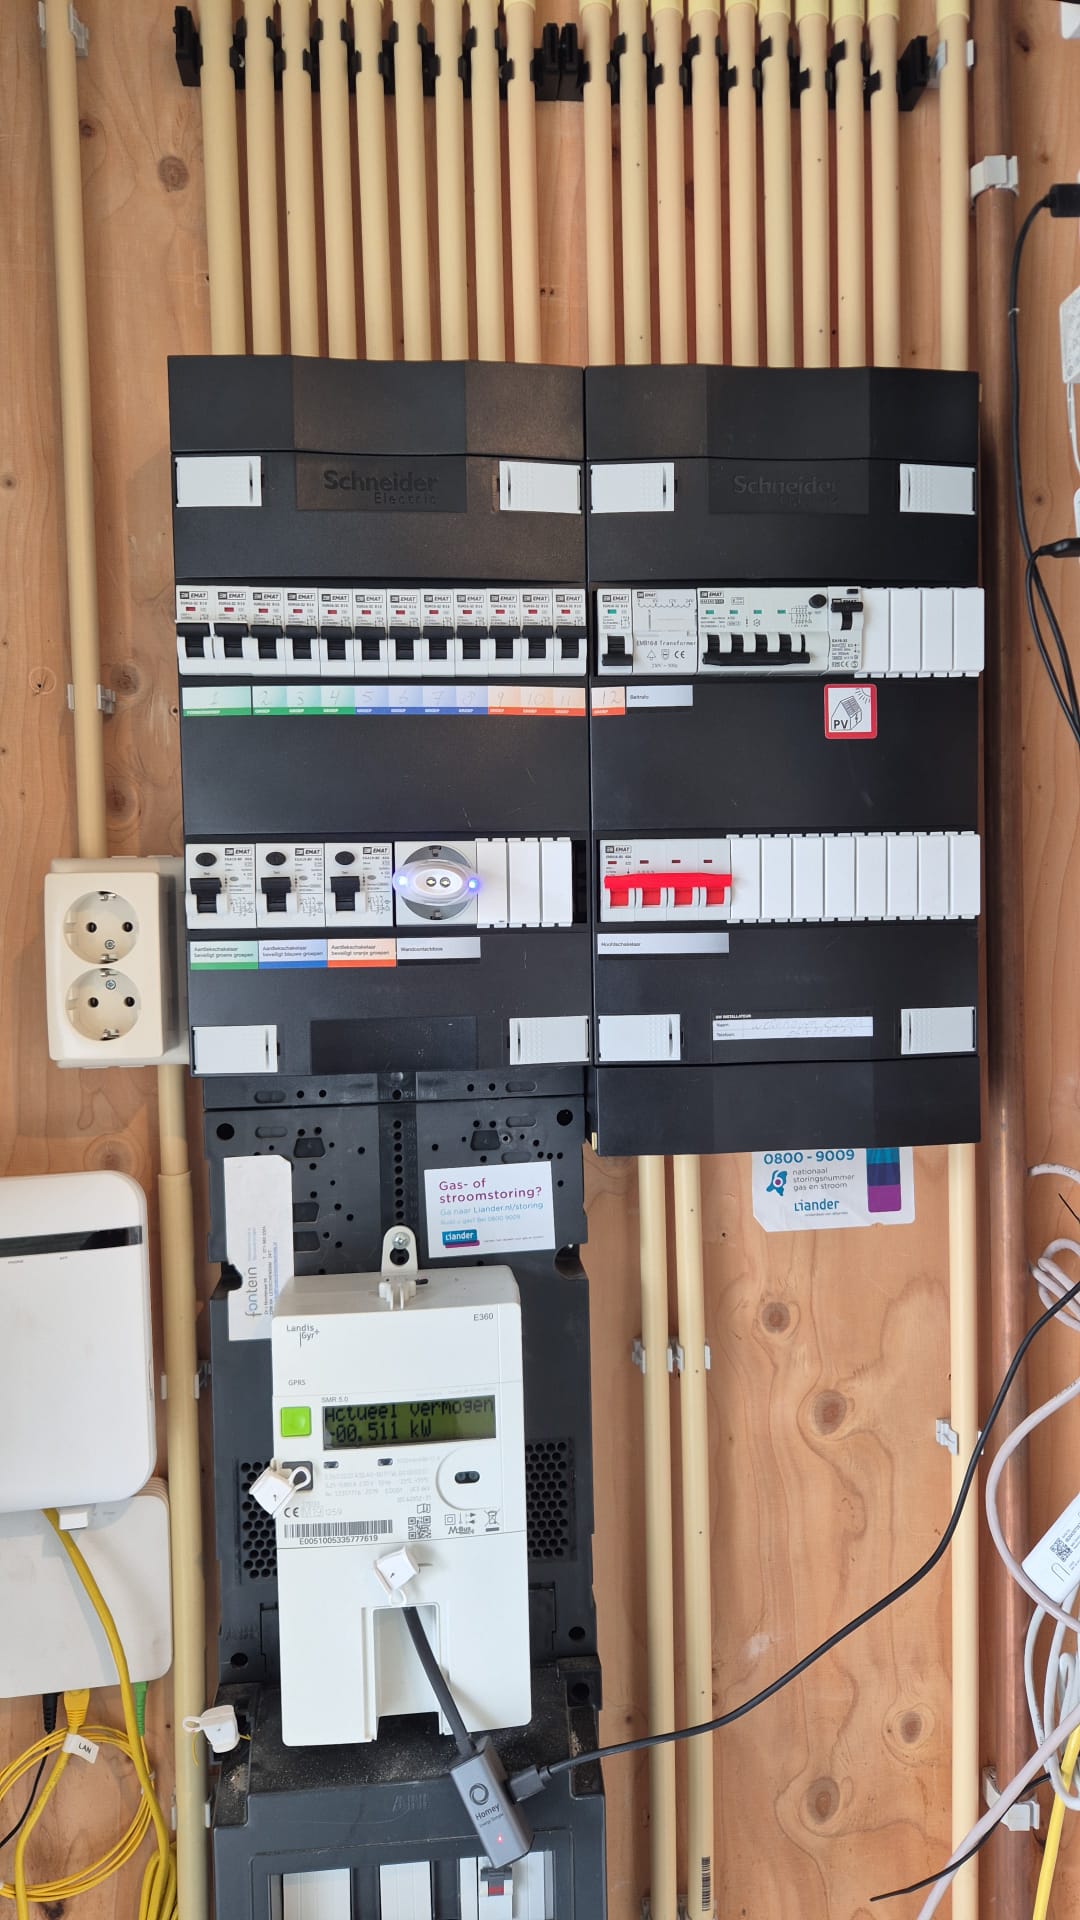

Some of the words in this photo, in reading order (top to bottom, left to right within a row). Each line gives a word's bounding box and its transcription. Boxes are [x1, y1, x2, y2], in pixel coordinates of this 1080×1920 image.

[323, 470, 438, 491] Schneider
[374, 492, 437, 504] Electric
[602, 690, 621, 705] 12
[833, 719, 849, 729] PV
[764, 1152, 804, 1165] 0800
[816, 1149, 855, 1162] 9009
[792, 1167, 828, 1176] nationaal
[439, 1180, 468, 1191] Gas-
[472, 1178, 486, 1188] of
[793, 1174, 855, 1184] storingsnummer
[794, 1184, 807, 1192] gas
[820, 1182, 848, 1190] stroom
[440, 1186, 542, 1204] stroomstoring?
[473, 1202, 544, 1214] Liander.nl/storing
[794, 1198, 840, 1212] Liander
[445, 1232, 474, 1241] Liander
[245, 1266, 262, 1317] fontein
[473, 1312, 494, 1322] E360
[286, 1324, 314, 1332] Landis
[325, 1405, 397, 1422] Actueel
[410, 1419, 432, 1438] kW
[300, 1535, 378, 1545] E0051005335777619
[78, 1742, 92, 1754] LAN
[475, 1804, 500, 1820] Homey
